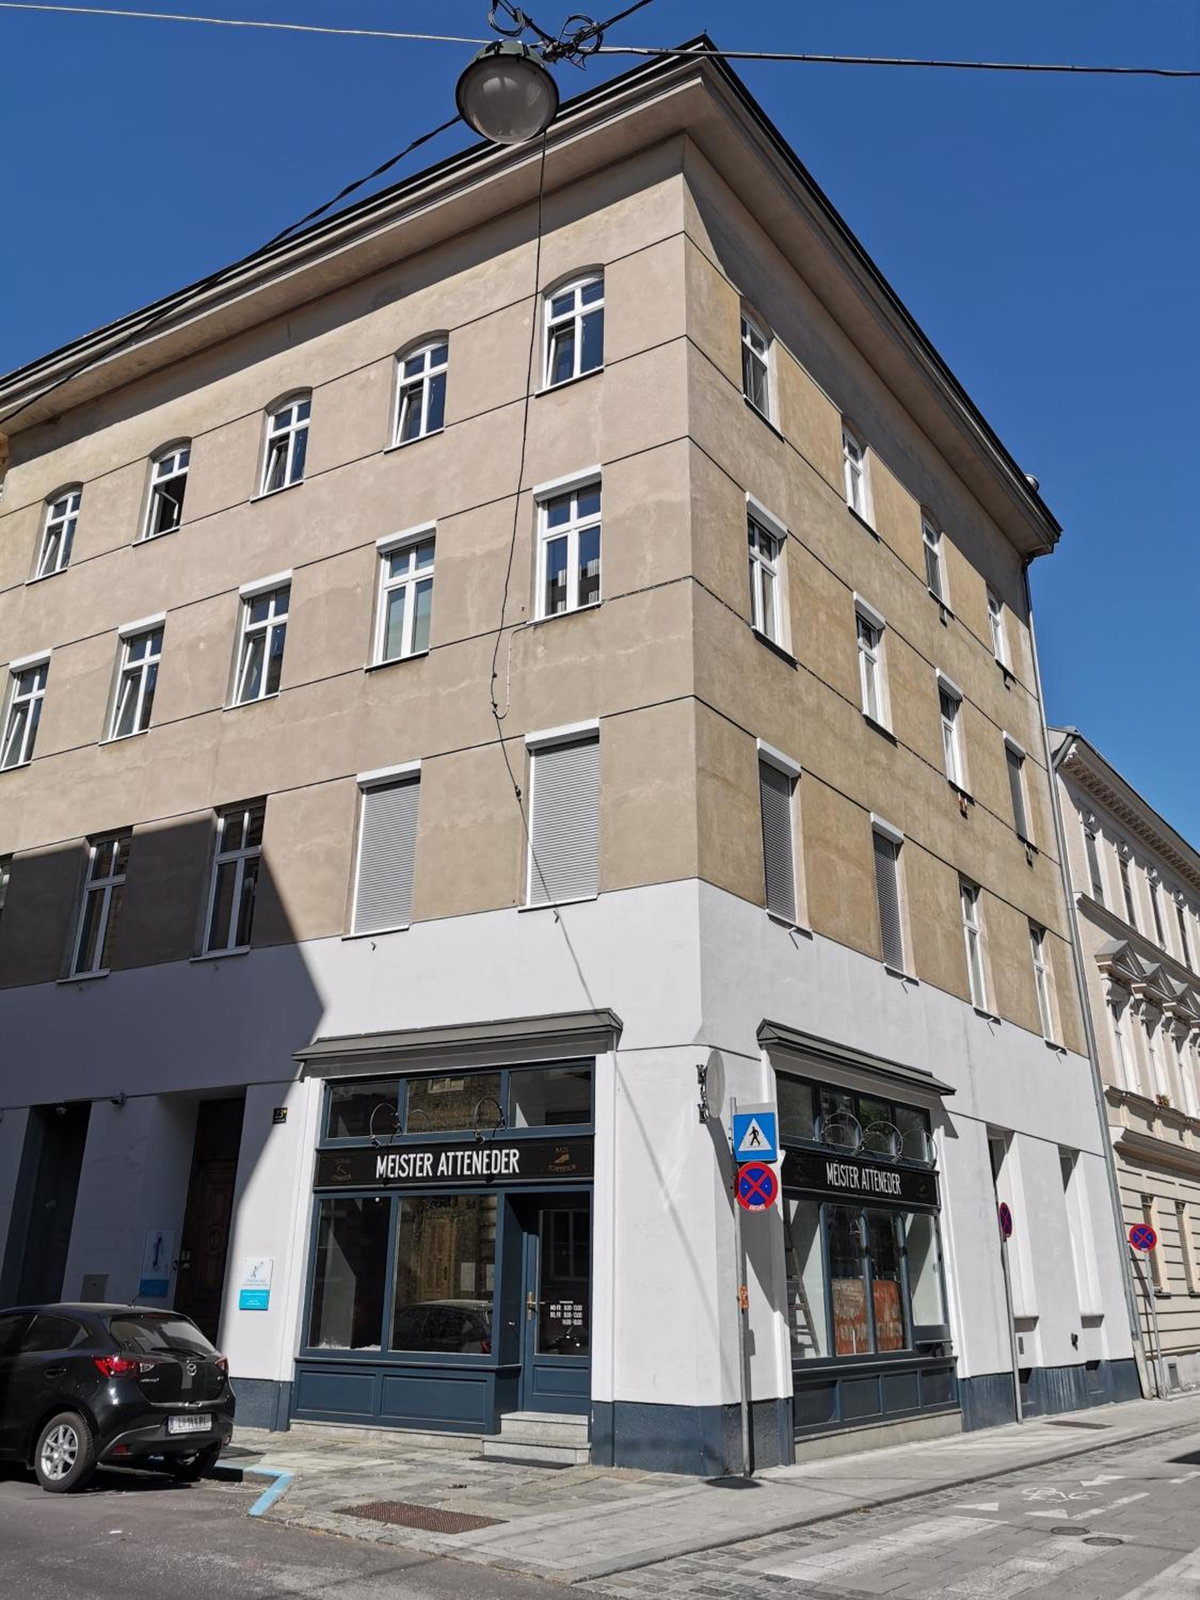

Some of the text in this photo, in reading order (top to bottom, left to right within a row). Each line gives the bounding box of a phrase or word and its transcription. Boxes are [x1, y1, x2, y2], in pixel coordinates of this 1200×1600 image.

[376, 1153, 433, 1178] MEISTER
[437, 1149, 520, 1176] ATTENEDER
[826, 1162, 902, 1195] MEISTER ATTENEDER
